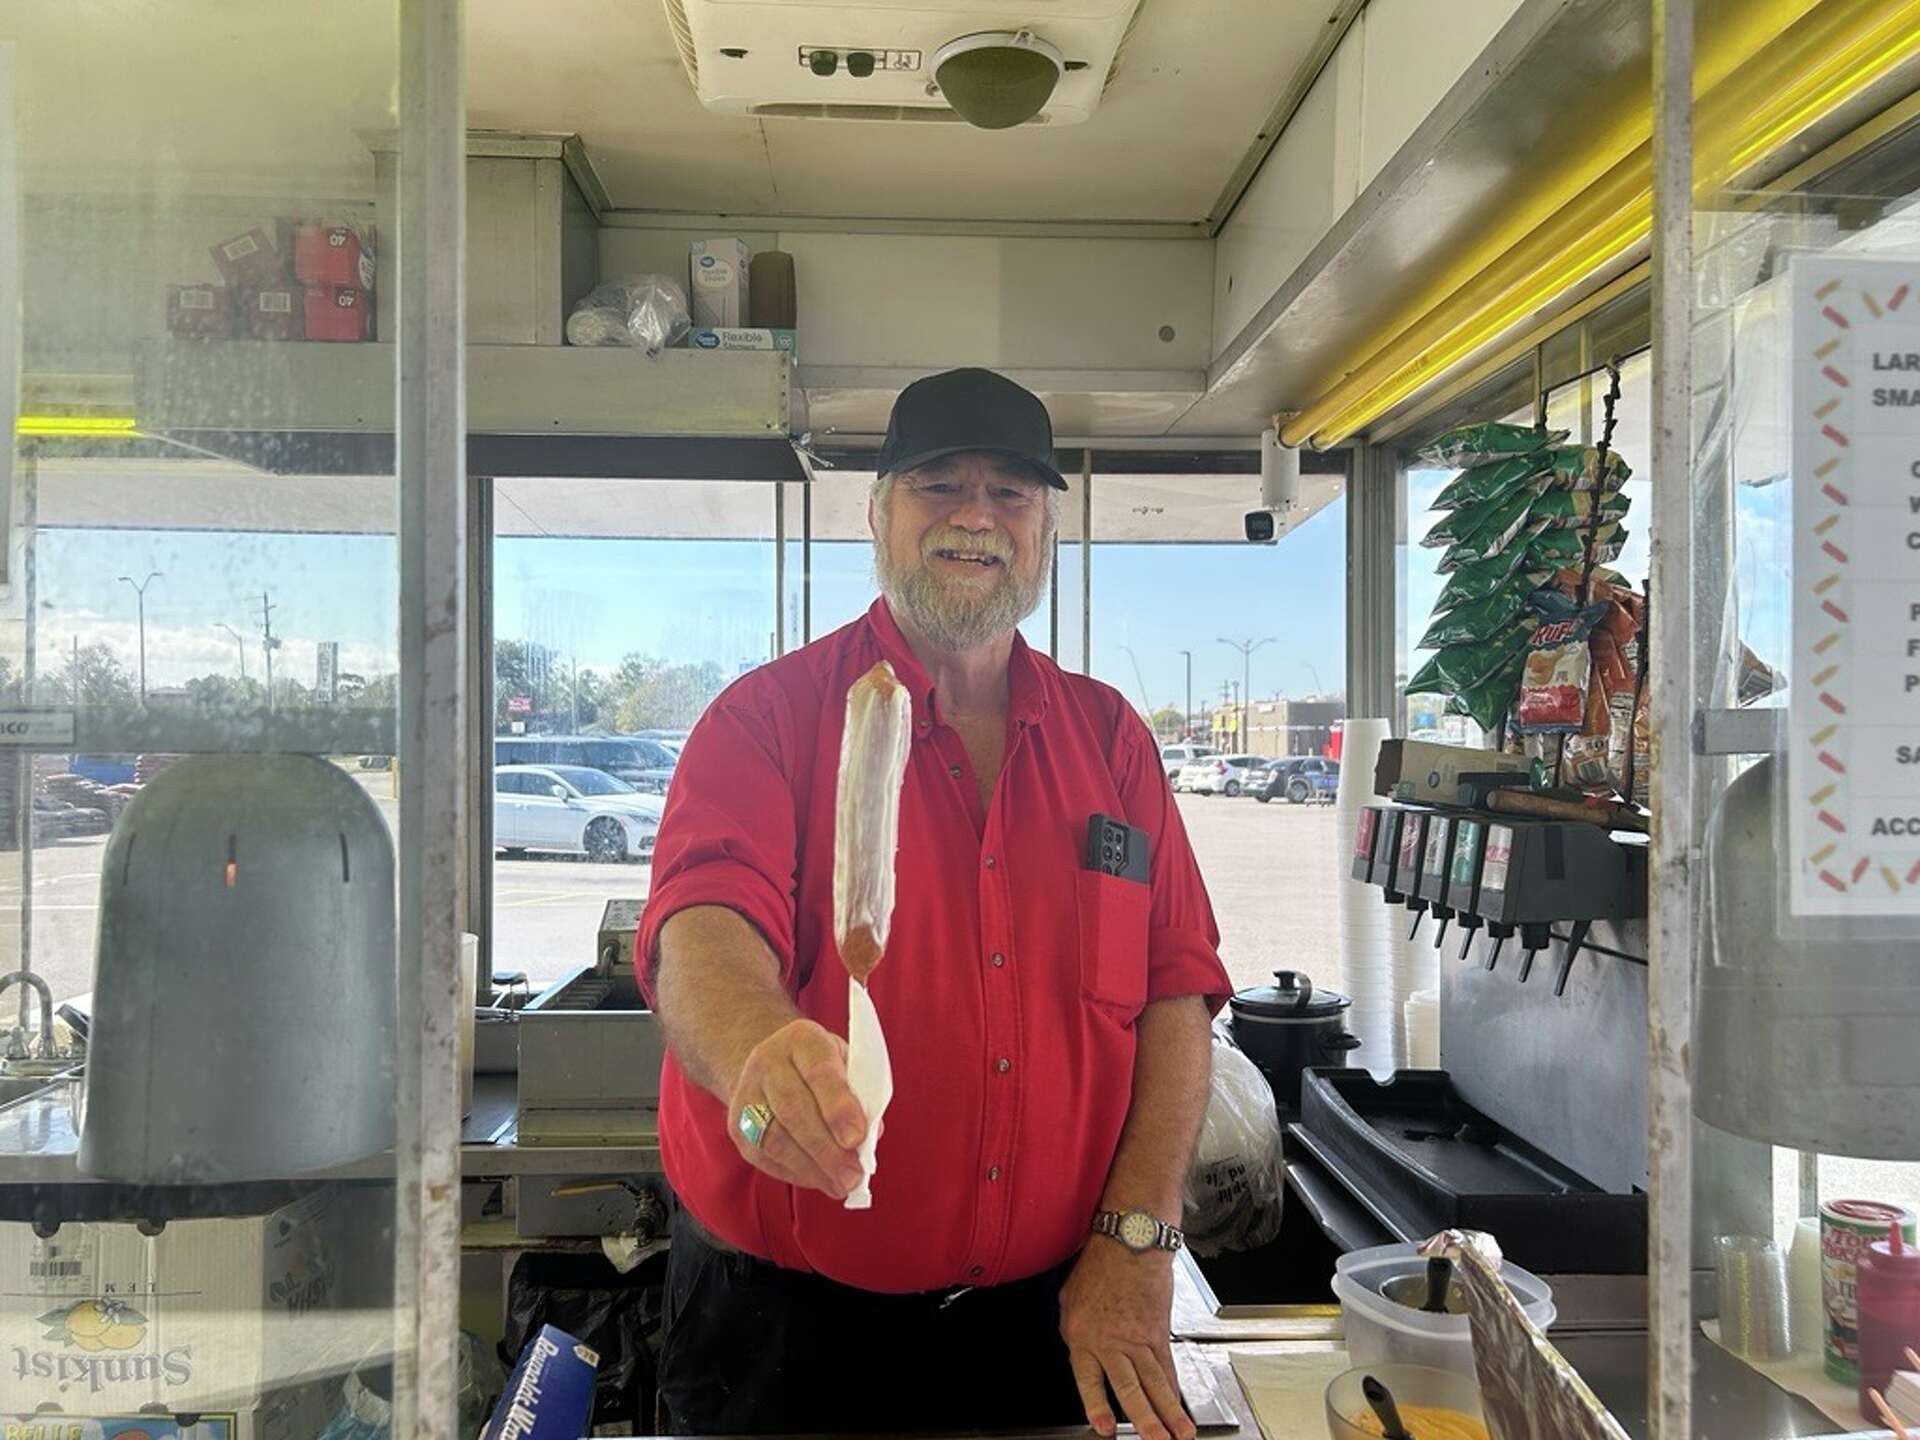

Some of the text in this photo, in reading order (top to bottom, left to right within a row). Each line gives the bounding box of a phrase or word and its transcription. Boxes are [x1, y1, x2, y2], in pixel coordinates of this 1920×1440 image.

[1873, 353, 1920, 371] LAR
[12, 1344, 192, 1393] Sunkist
[513, 1335, 559, 1407] Reynolds
